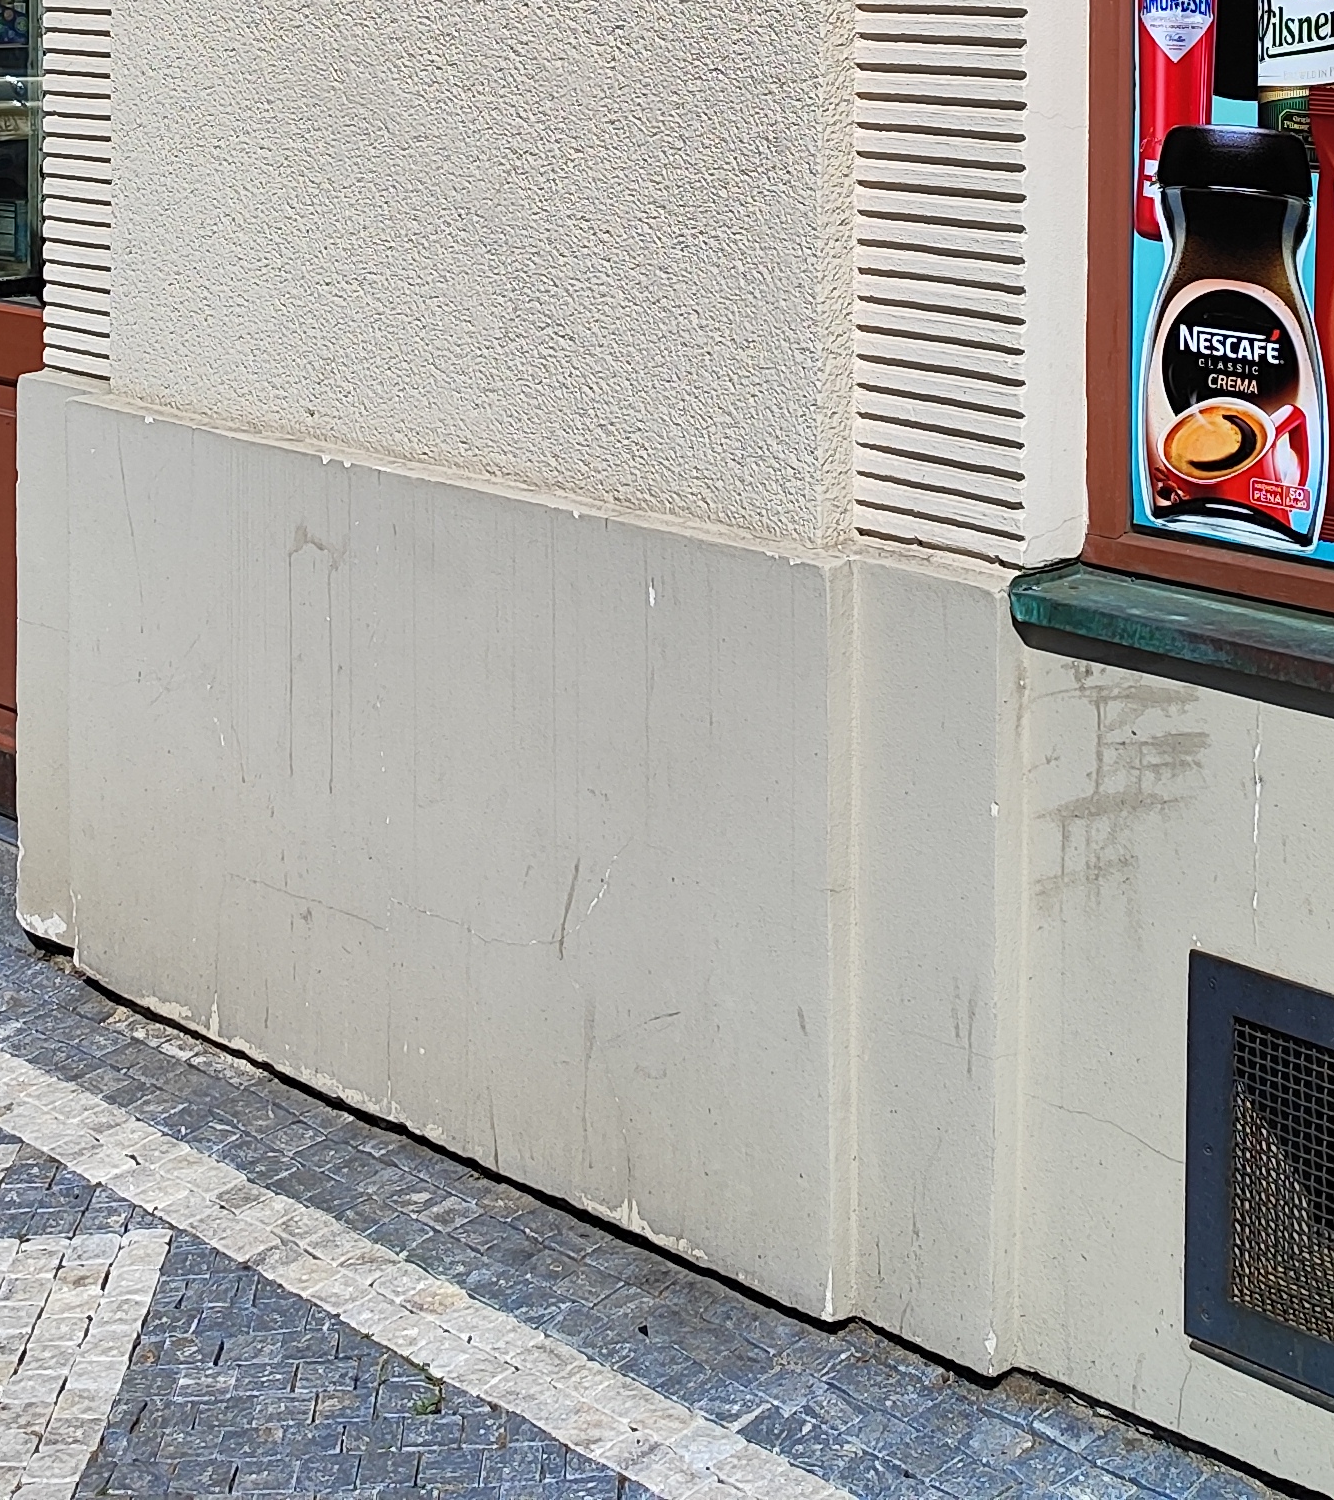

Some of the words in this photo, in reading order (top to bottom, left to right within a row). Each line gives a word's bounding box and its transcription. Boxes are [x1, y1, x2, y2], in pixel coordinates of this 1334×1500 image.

[1179, 324, 1281, 364] NESCAFÉ
[1198, 358, 1259, 375] CLASSIC
[1208, 374, 1258, 394] CREMA
